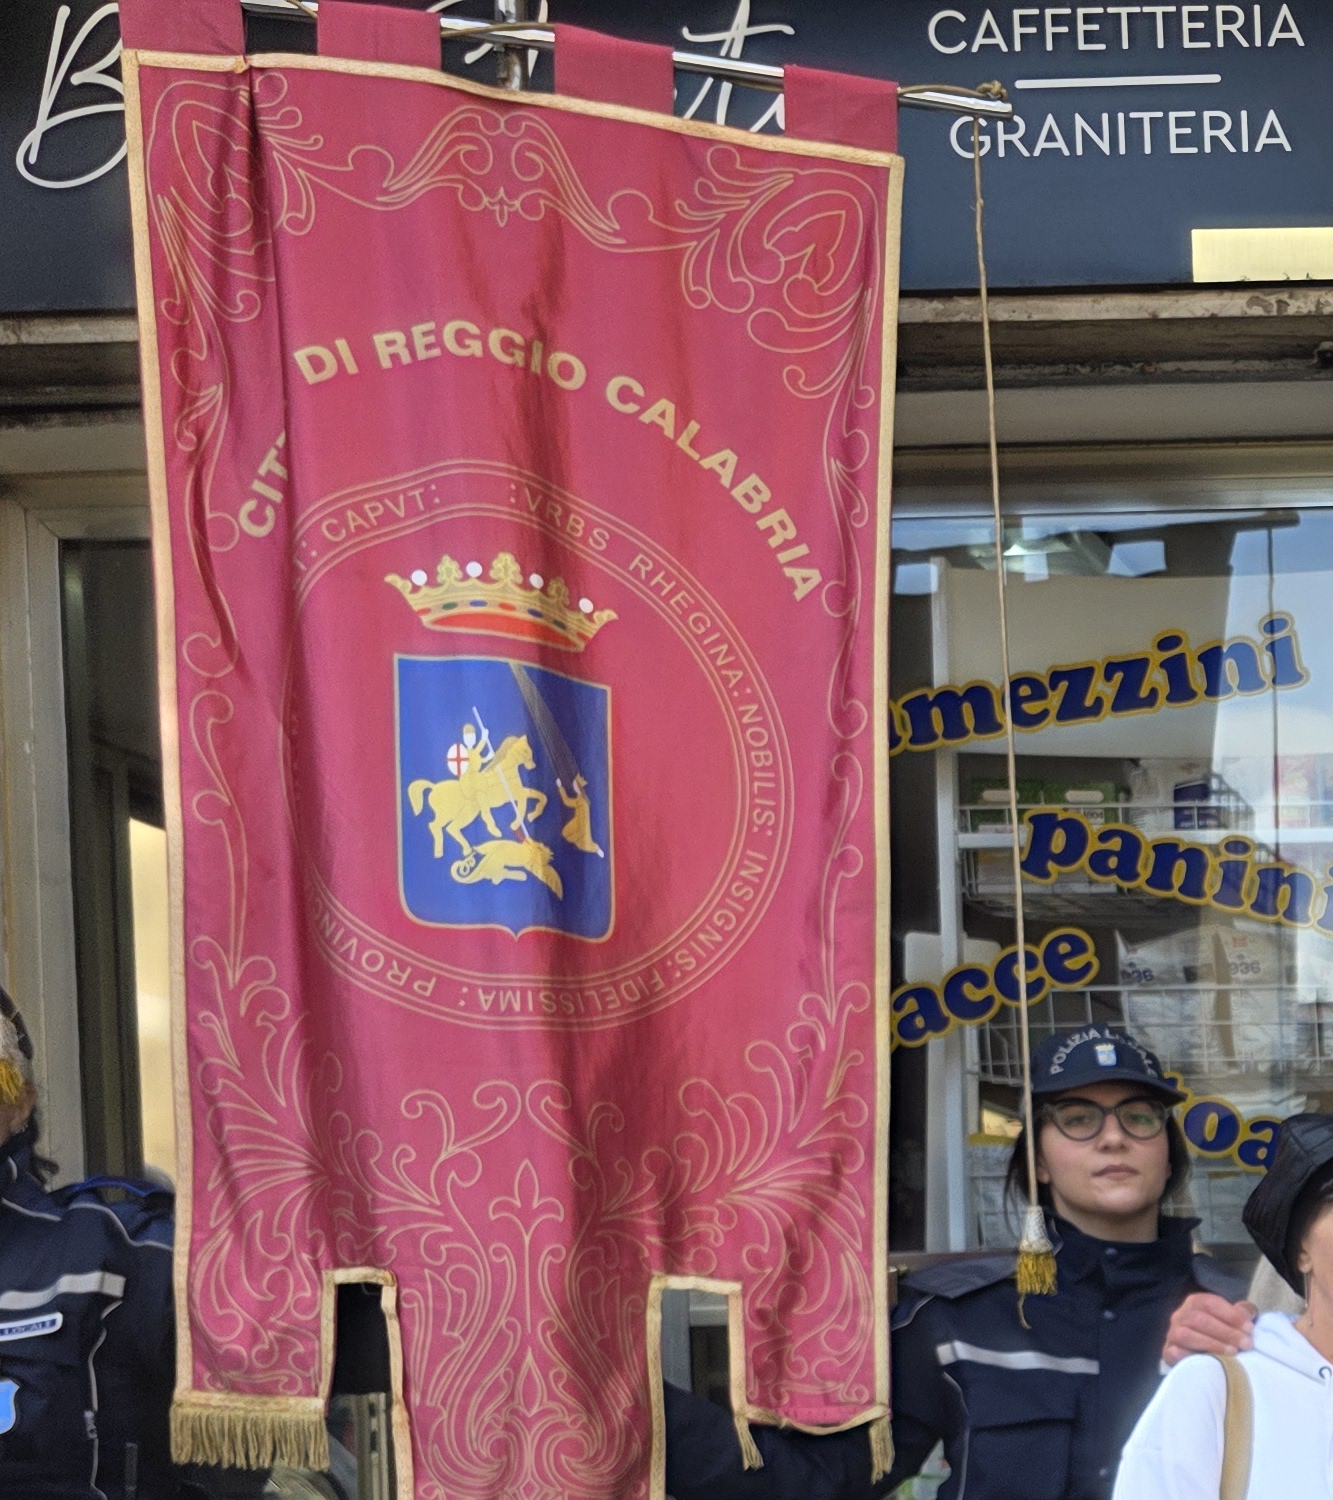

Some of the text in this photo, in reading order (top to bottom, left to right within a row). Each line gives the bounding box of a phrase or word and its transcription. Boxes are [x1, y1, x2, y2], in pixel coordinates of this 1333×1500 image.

[927, 3, 1305, 54] CAFFETTERIA
[949, 109, 1292, 159] GRANITERIA
[293, 338, 359, 385] DI
[373, 319, 587, 391] REGGIO
[605, 375, 822, 602] CALABRIA
[888, 612, 1309, 755] mezzini
[890, 927, 1100, 1050] acce
